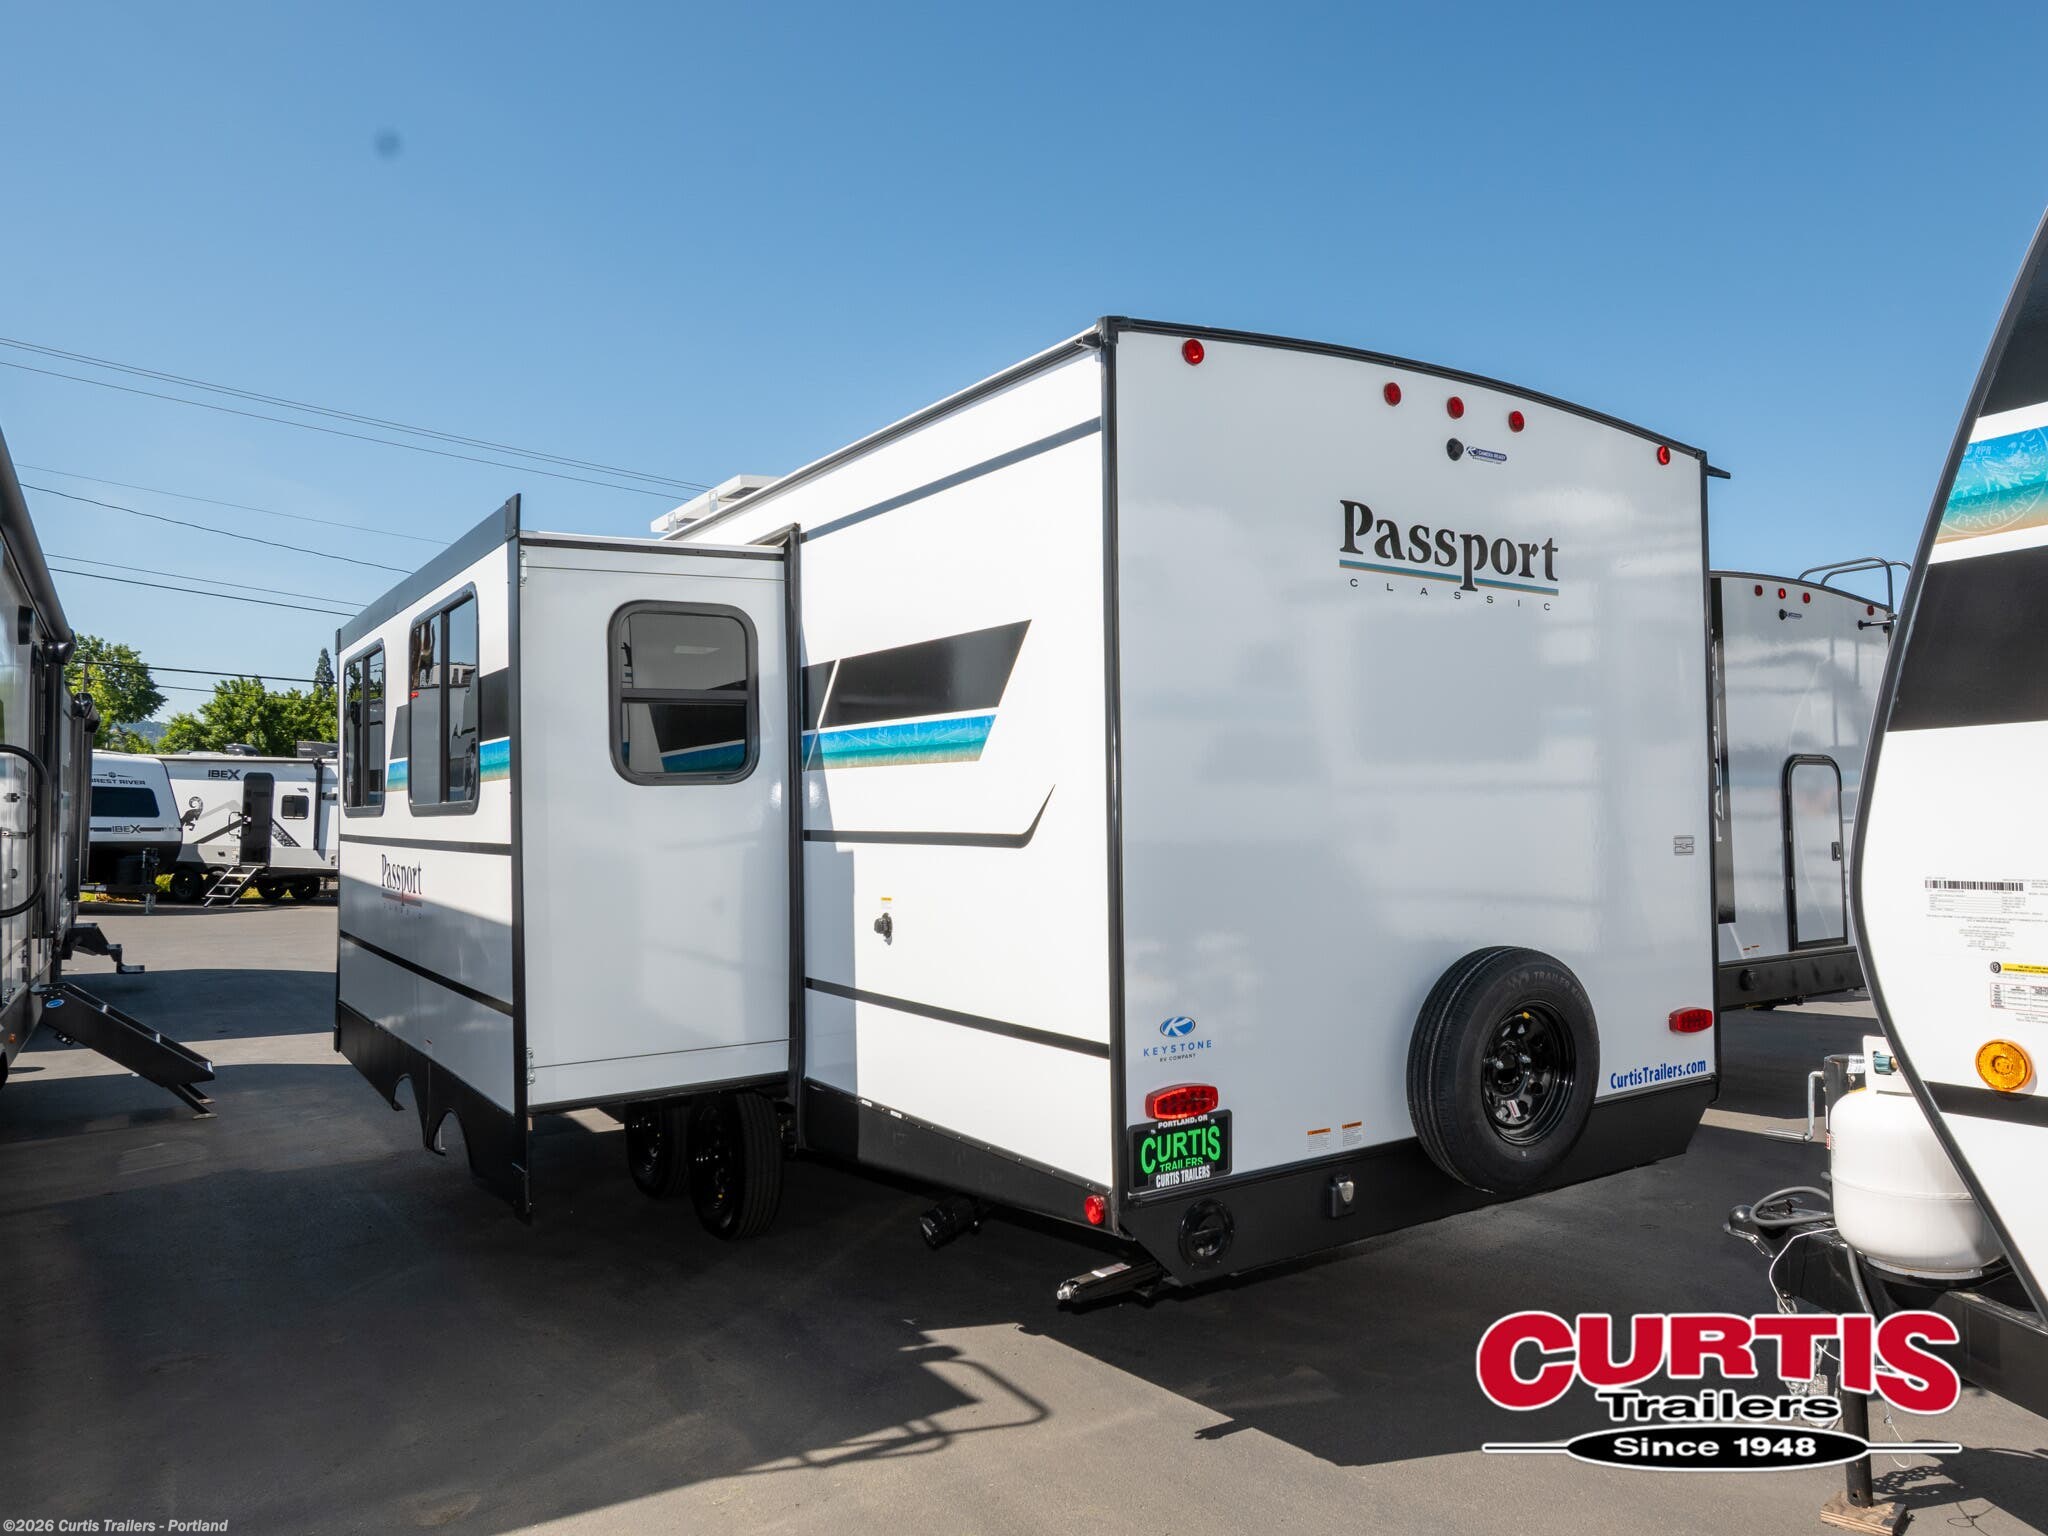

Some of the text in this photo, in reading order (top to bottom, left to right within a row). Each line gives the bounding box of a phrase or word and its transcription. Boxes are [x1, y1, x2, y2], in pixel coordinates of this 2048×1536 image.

[1339, 499, 1559, 592] Passport
[1349, 578, 1551, 611] CLASSIC
[208, 769, 241, 780] IBEX
[112, 824, 141, 834] IBEX
[381, 853, 422, 907] Passport
[1143, 1039, 1213, 1057] KEYSTONE
[1168, 1053, 1197, 1062] COMPANY
[1610, 1060, 1707, 1090] CurtisTrailers.com
[1198, 1114, 1208, 1123] OR
[1141, 1125, 1221, 1174] CURTIS
[1159, 1156, 1204, 1173] TRAILERS
[1155, 1164, 1211, 1189] CURTIS TRAILERS
